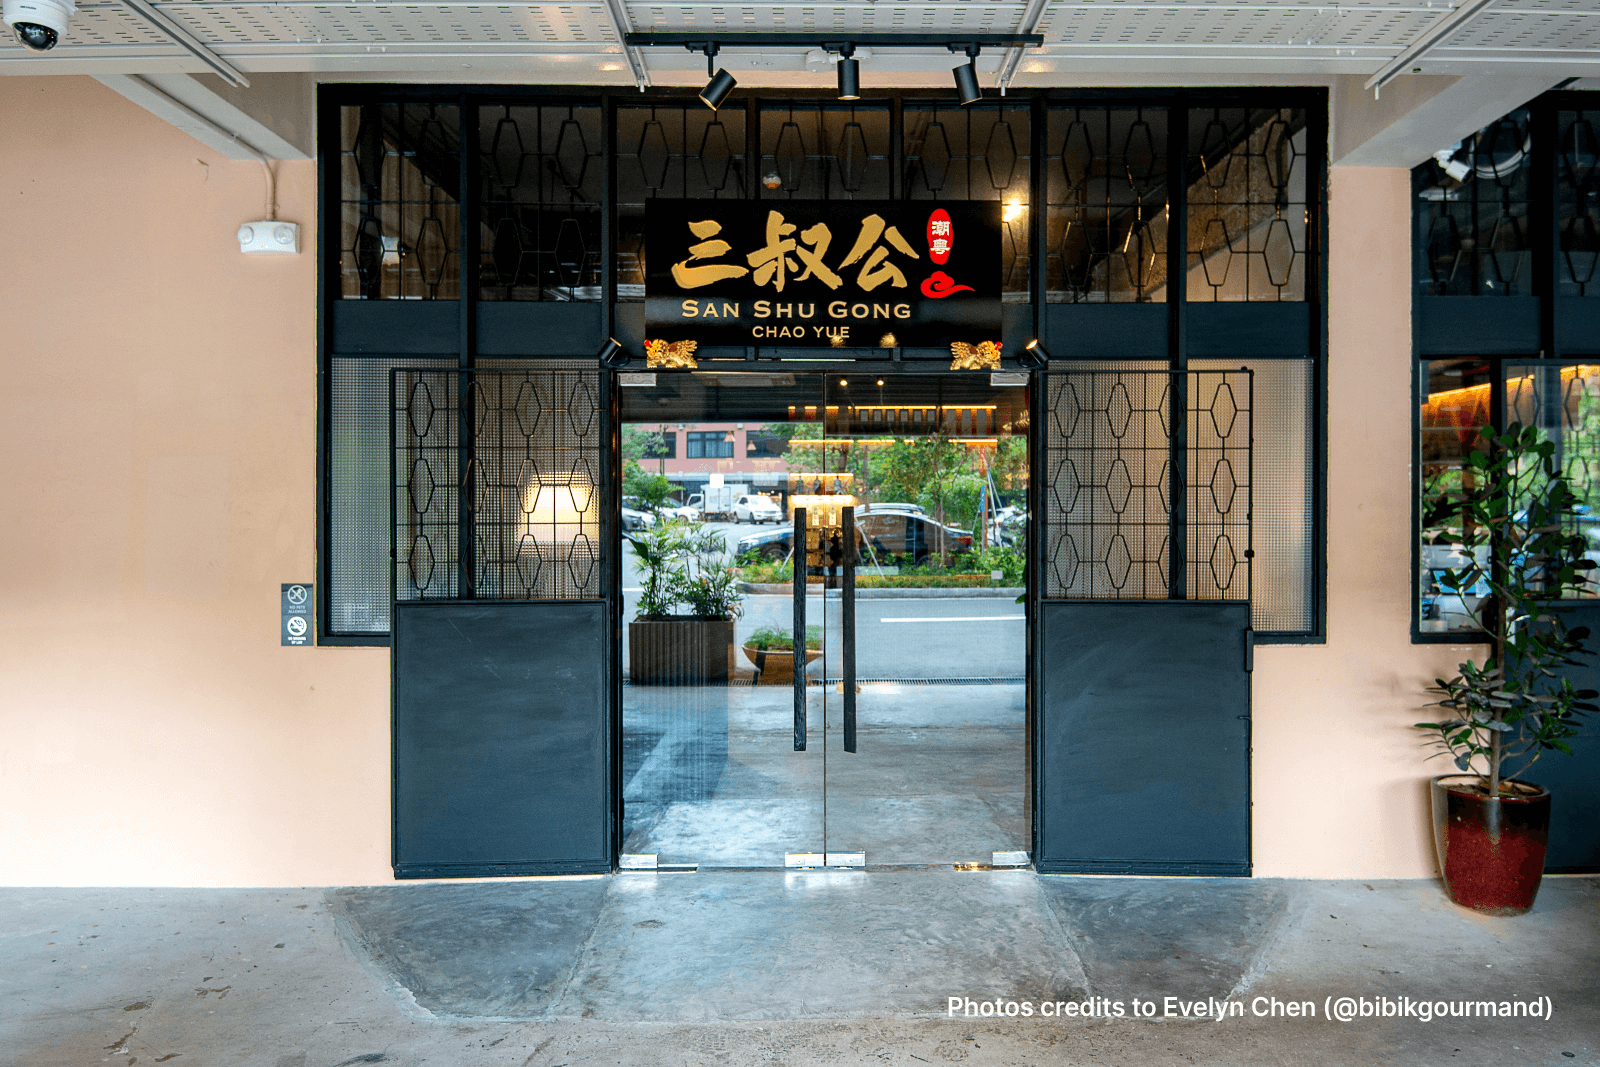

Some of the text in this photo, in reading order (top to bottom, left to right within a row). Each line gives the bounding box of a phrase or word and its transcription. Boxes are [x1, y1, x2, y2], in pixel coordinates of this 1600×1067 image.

[671, 210, 920, 293] 三叔公
[752, 326, 850, 339] CHAO YUE
